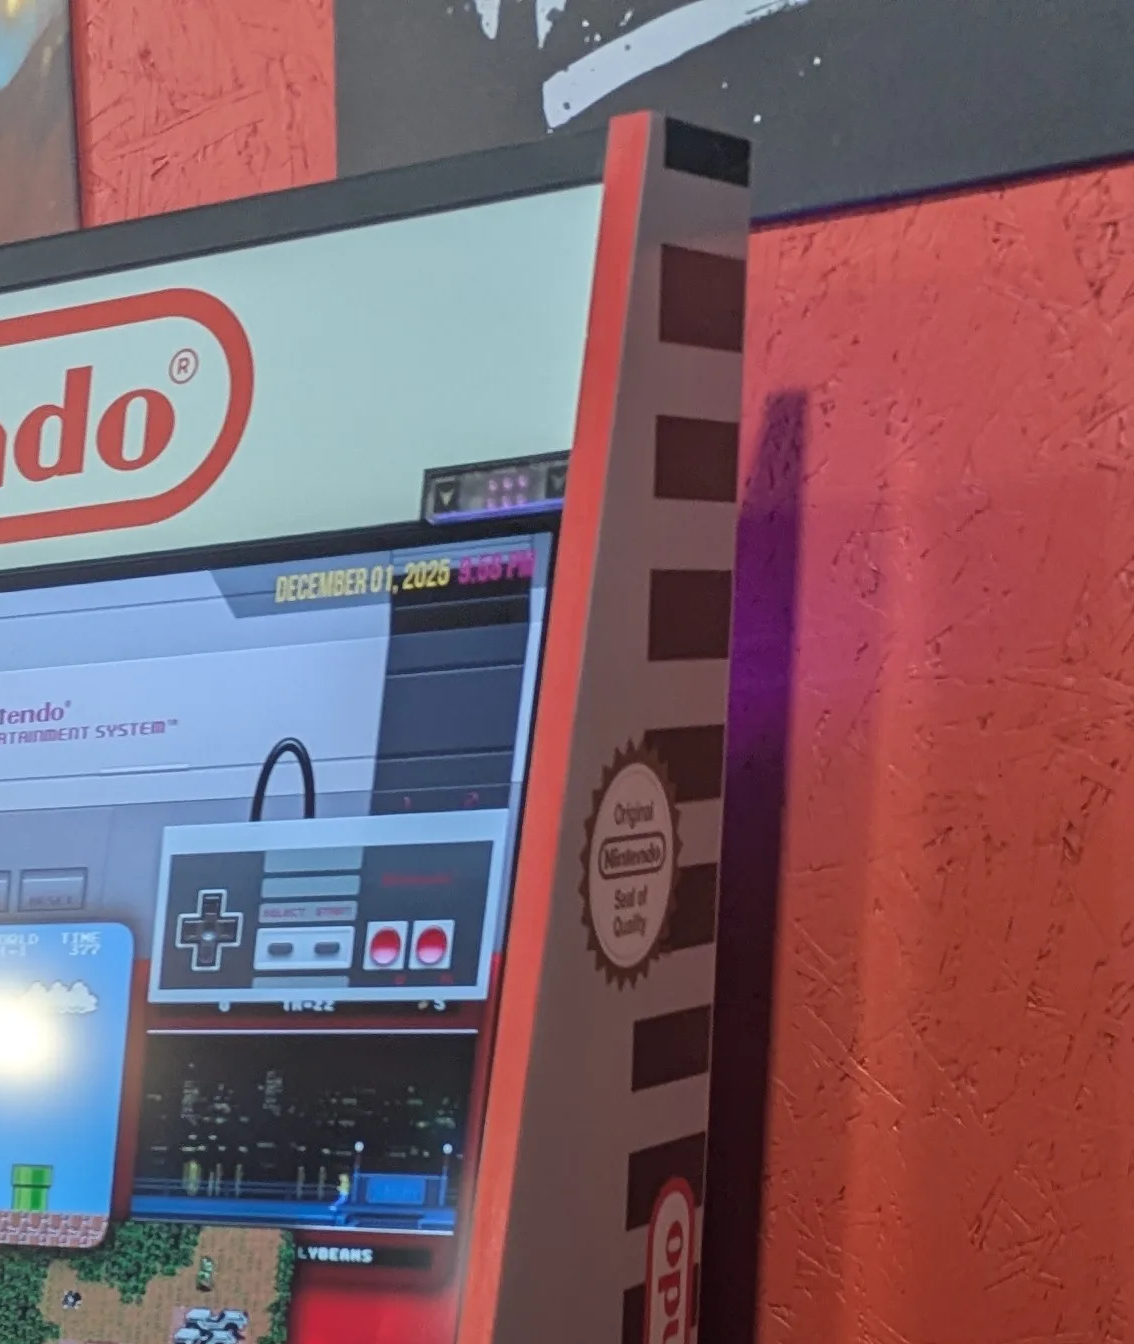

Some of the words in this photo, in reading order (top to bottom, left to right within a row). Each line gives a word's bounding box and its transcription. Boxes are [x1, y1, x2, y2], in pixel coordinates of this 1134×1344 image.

[275, 567, 367, 603] DECEMBER
[369, 565, 398, 595] 01,
[613, 802, 655, 829] Original
[604, 842, 662, 870] Nintendo
[614, 886, 636, 910] Seal
[637, 884, 648, 907] of
[61, 931, 102, 945] TIME
[613, 914, 647, 938] Quality
